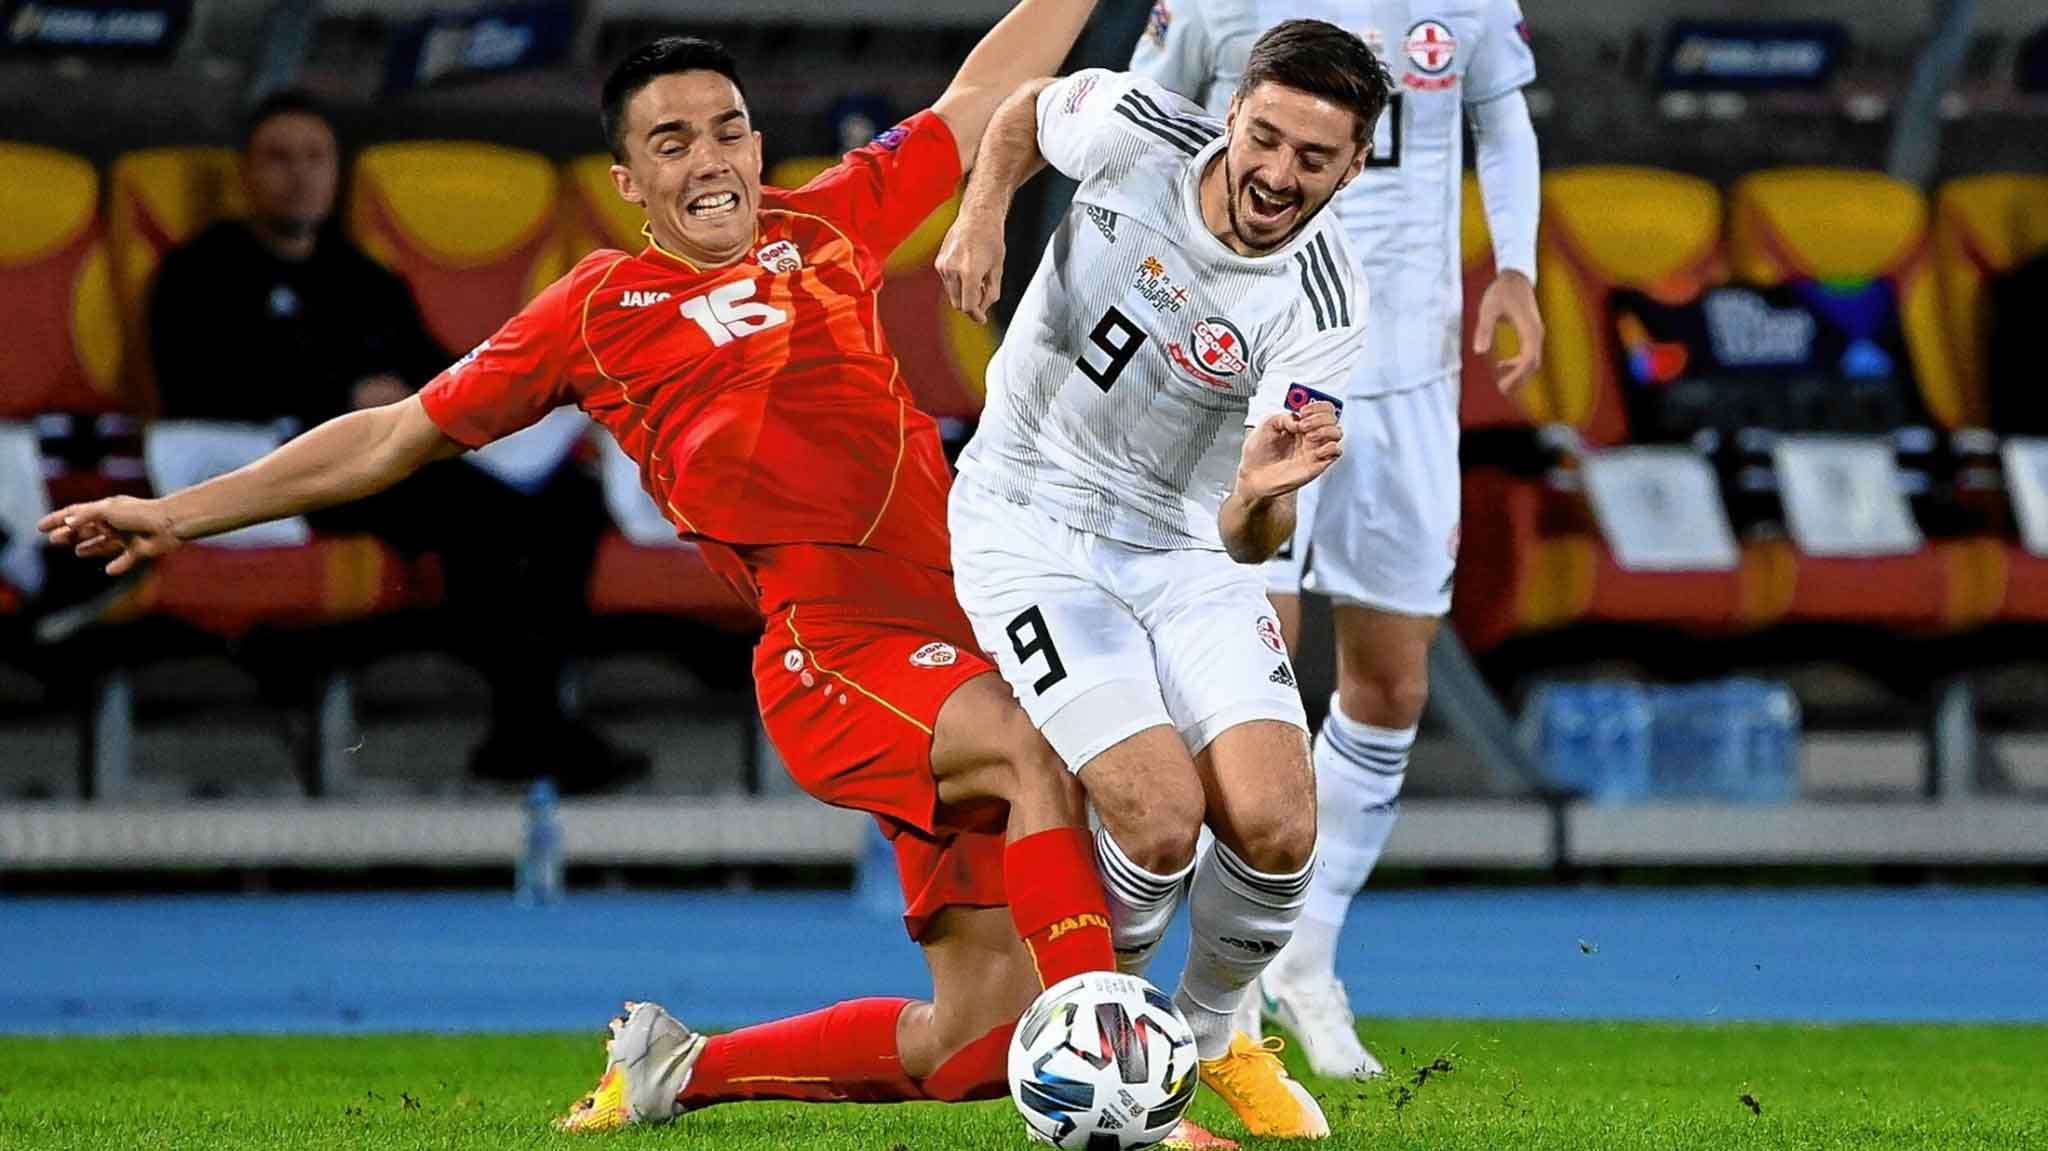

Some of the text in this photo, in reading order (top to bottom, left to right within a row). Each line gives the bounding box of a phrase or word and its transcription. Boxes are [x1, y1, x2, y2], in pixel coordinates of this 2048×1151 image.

[1087, 206, 1117, 245] adidas
[679, 277, 788, 348] 15
[1075, 304, 1149, 394] 9
[1005, 604, 1068, 697] 9
